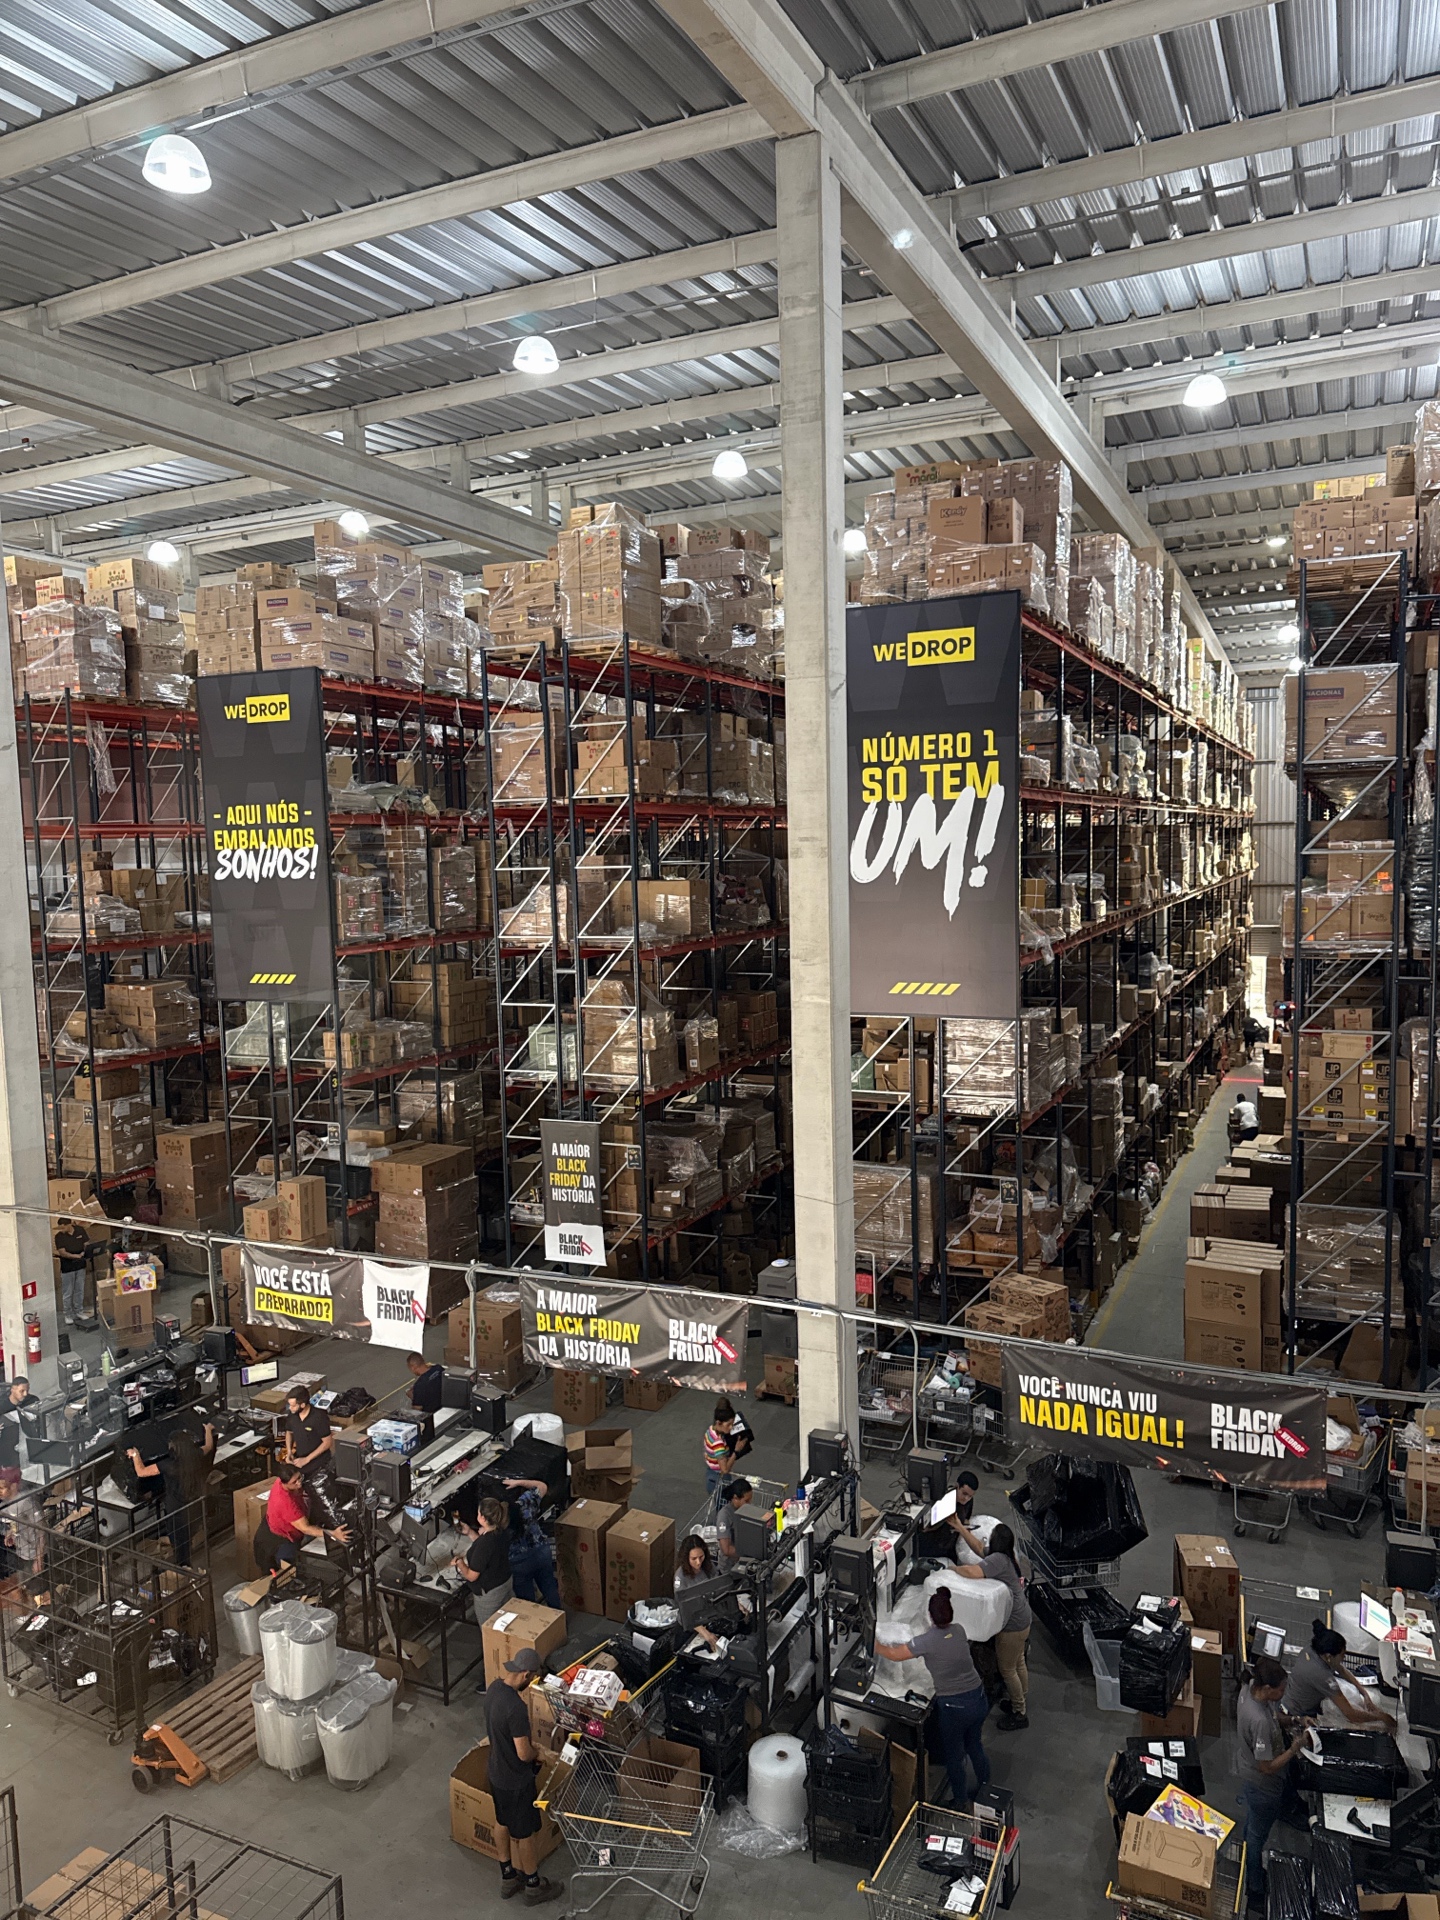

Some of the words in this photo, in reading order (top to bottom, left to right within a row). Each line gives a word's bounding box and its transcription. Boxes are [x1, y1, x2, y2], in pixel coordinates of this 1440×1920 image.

[1305, 689, 1342, 697] NACIONAL
[862, 730, 972, 764] NÚMERO
[983, 729, 999, 757] 1
[862, 757, 908, 804] SÓ
[919, 760, 1000, 801] TEM
[226, 804, 262, 827] AQUI
[265, 799, 299, 824] NÓS
[213, 827, 316, 851] EMBALAMOS
[850, 782, 1006, 922] UM!
[213, 841, 319, 884] SONHOS!
[83, 1064, 90, 1074] 2
[332, 1077, 338, 1088] 3
[551, 1142, 559, 1156] A
[559, 1142, 591, 1158] MAIOR
[556, 1157, 587, 1173] BLACK
[549, 1172, 582, 1188] FRIDAY
[582, 1175, 596, 1189] DA
[551, 1186, 595, 1204] HISTÓRIA
[558, 1232, 584, 1246] BLACK
[559, 1244, 586, 1257] FRIDAY
[252, 1263, 290, 1292] VOCÊ
[291, 1267, 333, 1297] ESTÁ
[256, 1290, 331, 1320] PREPARADO?
[376, 1285, 415, 1305] BLACK
[536, 1289, 546, 1310] A
[549, 1290, 598, 1316] MAIOR
[376, 1302, 418, 1324] FRIDAY
[536, 1312, 585, 1337] BLACK
[589, 1317, 641, 1345] FRIDAY
[668, 1318, 718, 1344] BLACK
[538, 1335, 559, 1357] DA
[563, 1337, 632, 1368] HISTÓRIA
[667, 1340, 723, 1366] FRIDAY
[1018, 1373, 1061, 1399] VOCÊ
[1065, 1381, 1123, 1410] NUNCA
[1127, 1390, 1158, 1414] VIU
[1019, 1394, 1089, 1436] NADA
[1095, 1406, 1185, 1450] IGUAL!
[1210, 1402, 1283, 1434] BLACK
[1210, 1427, 1286, 1459] FRIDAY
[1280, 1431, 1306, 1453] WEDROP
